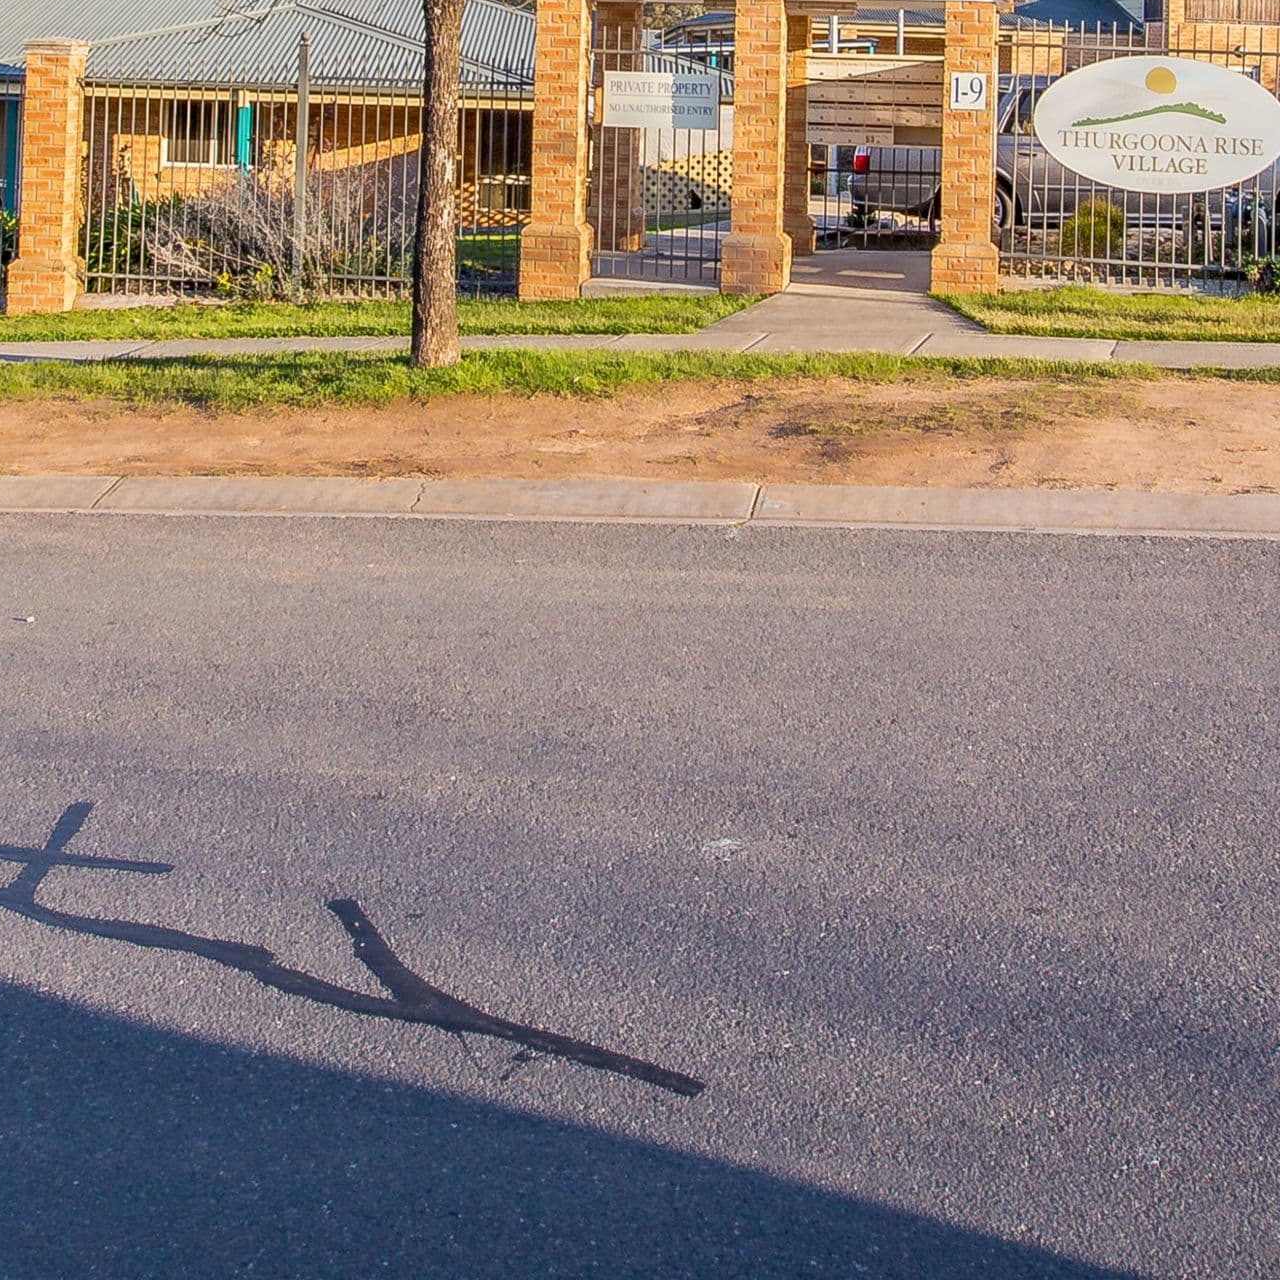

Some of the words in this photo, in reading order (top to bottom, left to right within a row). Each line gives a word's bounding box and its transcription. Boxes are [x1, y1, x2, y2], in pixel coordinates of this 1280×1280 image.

[610, 80, 654, 93] PRIVATE
[658, 82, 713, 96] PROPERTY
[954, 76, 983, 104] 1-9
[609, 103, 620, 112] NO
[623, 104, 685, 115] UNAUTHORISED
[687, 106, 714, 116] ENTRY
[1057, 129, 1208, 154] THURGOONA
[1213, 136, 1265, 156] RISE
[1111, 154, 1208, 175] VILLAGE
